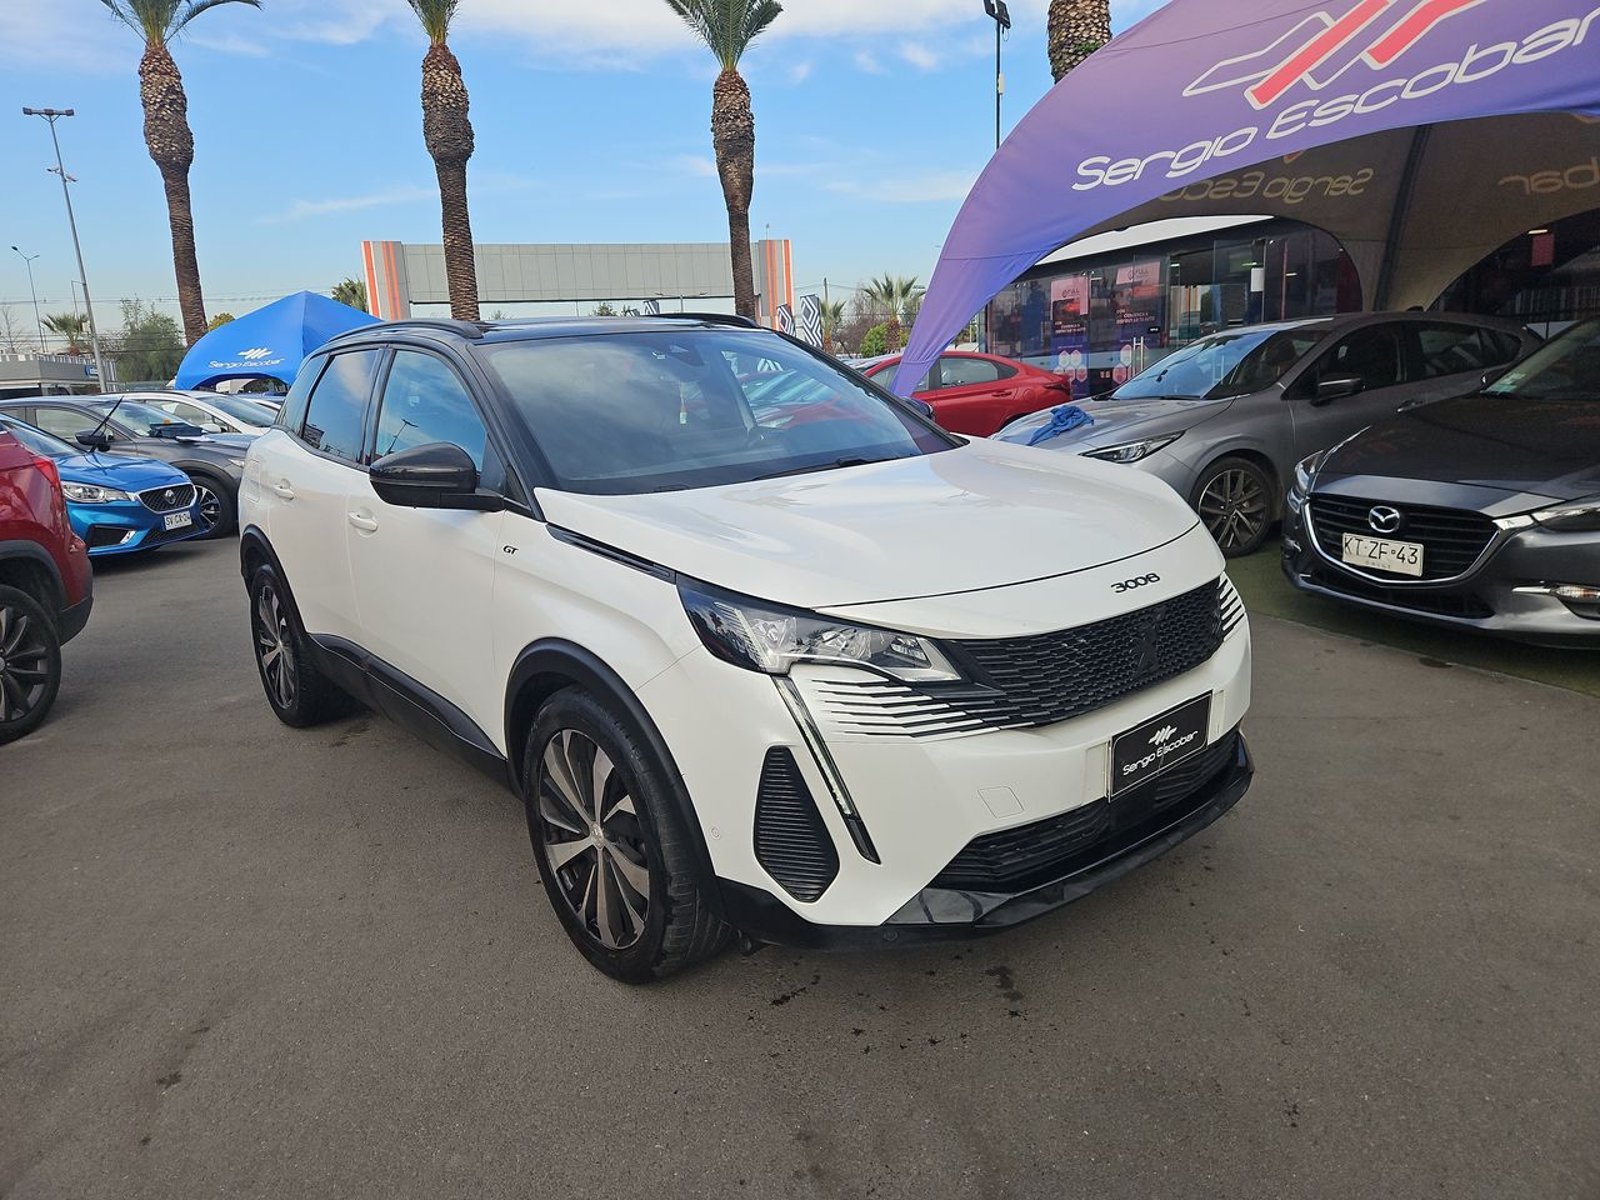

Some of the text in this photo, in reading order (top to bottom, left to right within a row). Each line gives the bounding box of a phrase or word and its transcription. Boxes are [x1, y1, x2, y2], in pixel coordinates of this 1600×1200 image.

[1072, 126, 1258, 190] Sergio
[503, 545, 519, 555] GT
[1110, 572, 1161, 594] 3008
[1122, 730, 1199, 776] Sergio Escobar
